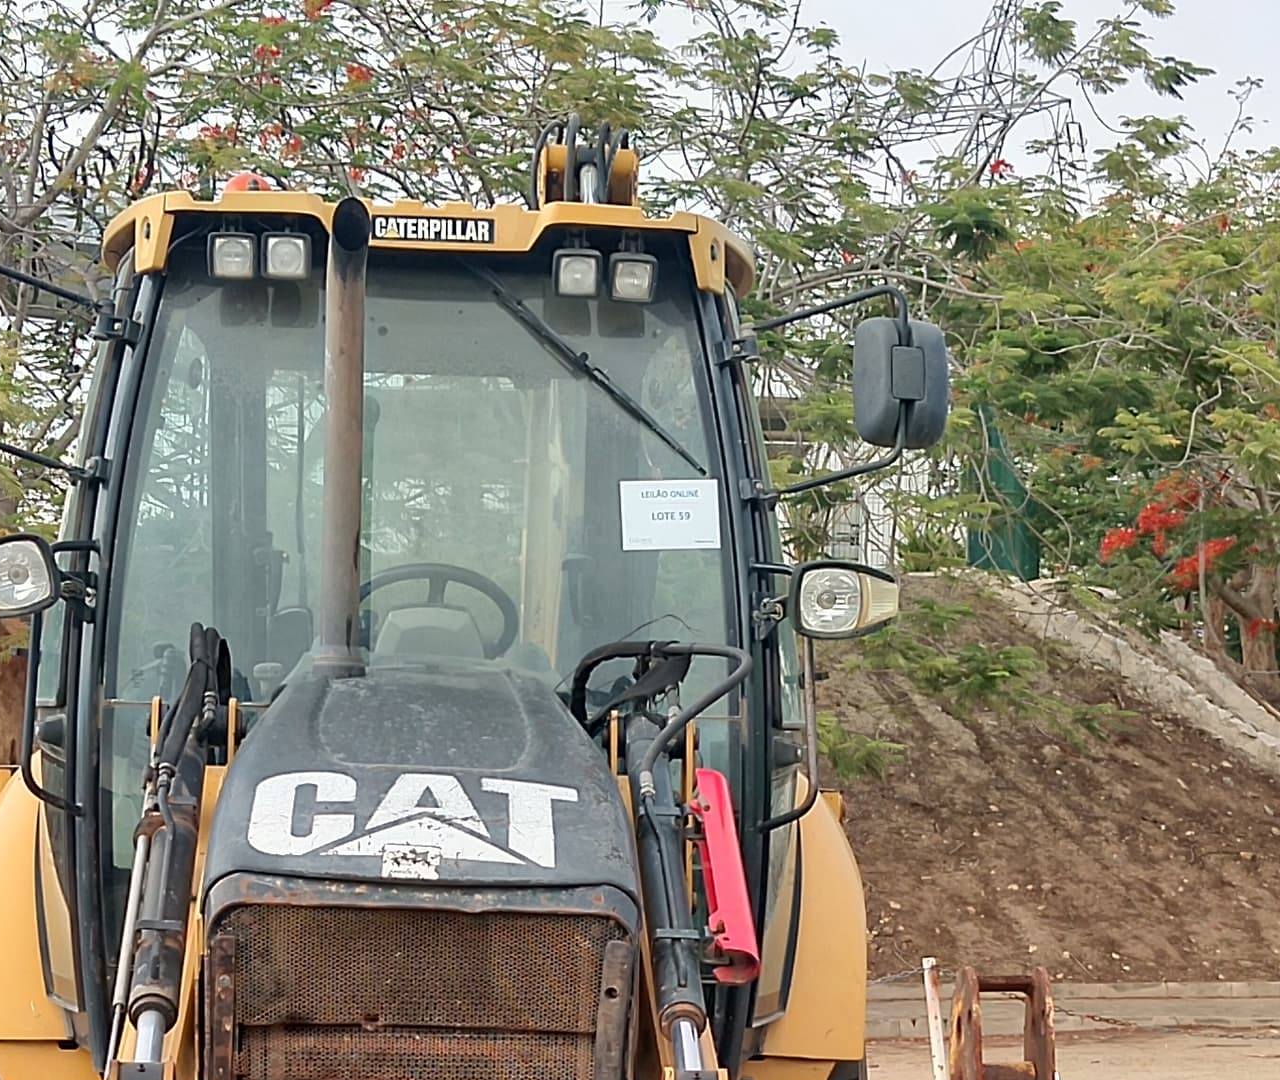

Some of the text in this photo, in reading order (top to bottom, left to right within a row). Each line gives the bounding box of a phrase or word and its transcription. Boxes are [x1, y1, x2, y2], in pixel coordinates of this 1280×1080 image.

[375, 217, 489, 241] CATERPILLAR
[670, 489, 699, 498] ONLINE
[651, 511, 676, 521] LOTE
[247, 771, 579, 869] CAT
